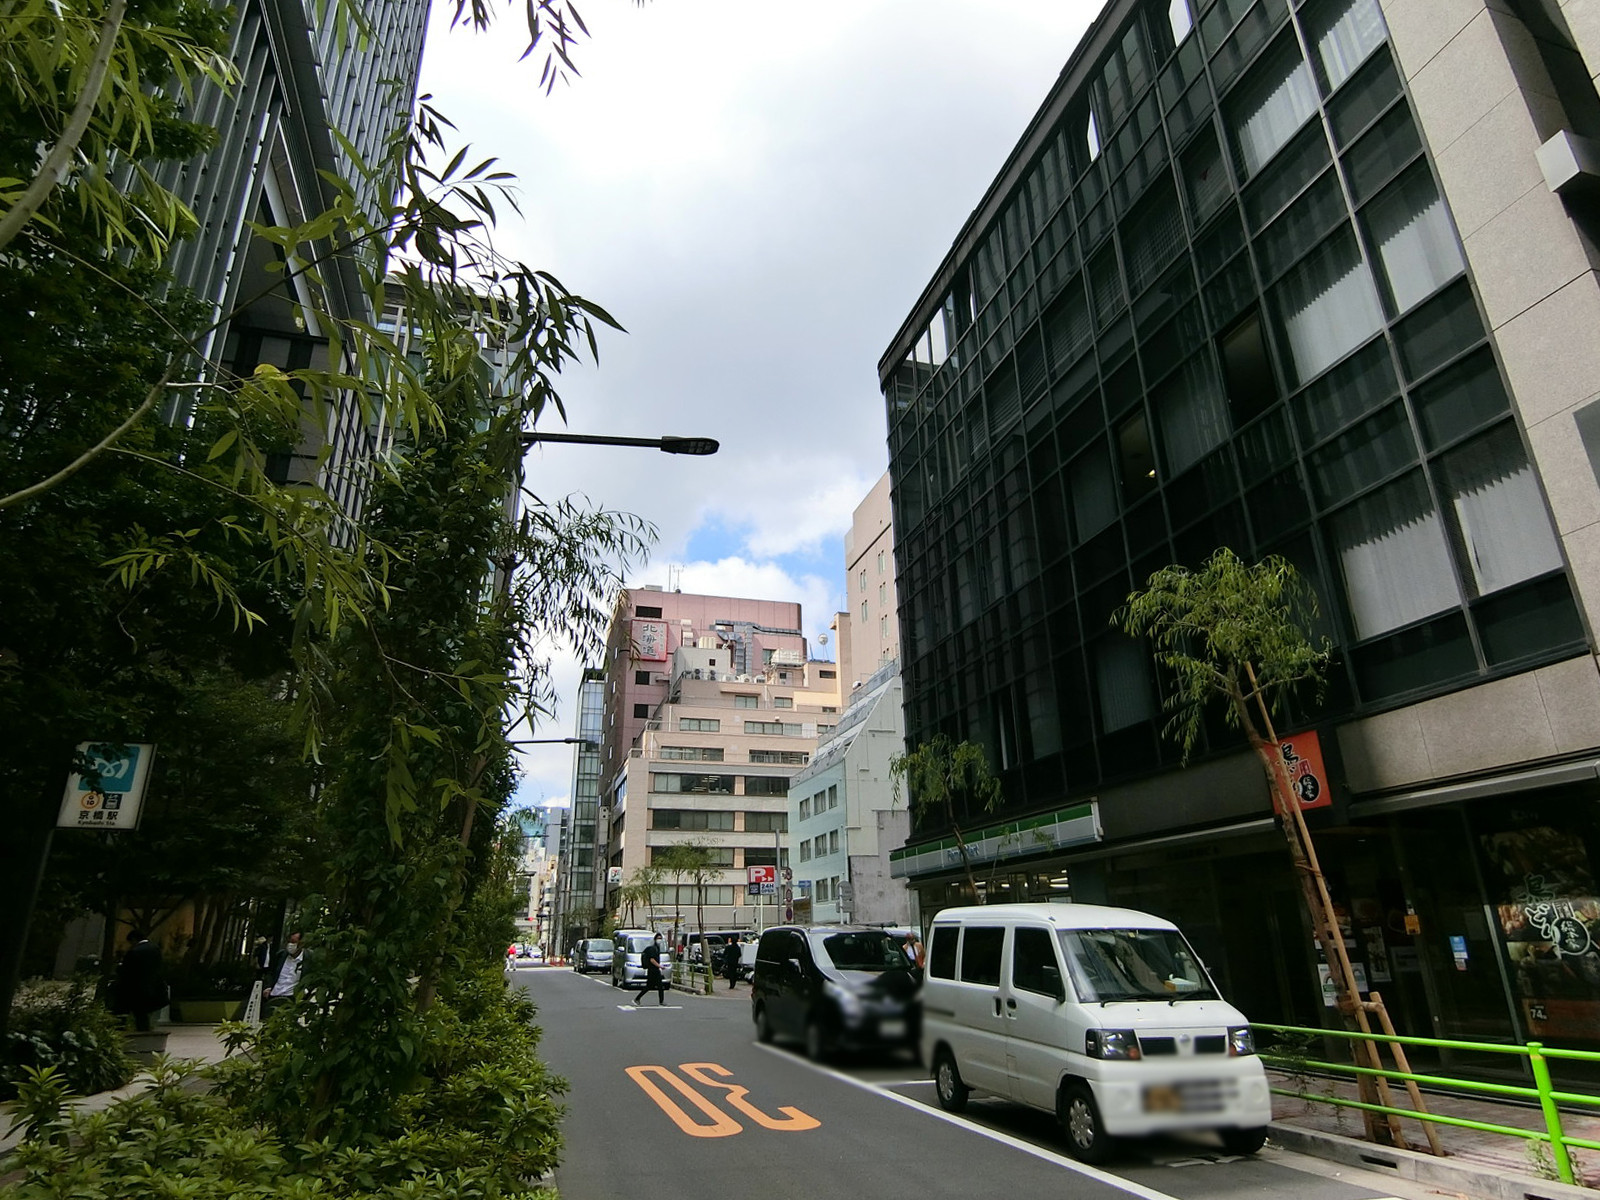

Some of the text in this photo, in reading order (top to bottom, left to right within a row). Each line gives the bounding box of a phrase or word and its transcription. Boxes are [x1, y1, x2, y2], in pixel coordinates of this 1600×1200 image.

[78, 810, 119, 820] 京橋駅
[750, 868, 766, 882] P
[624, 1062, 822, 1138] 30
